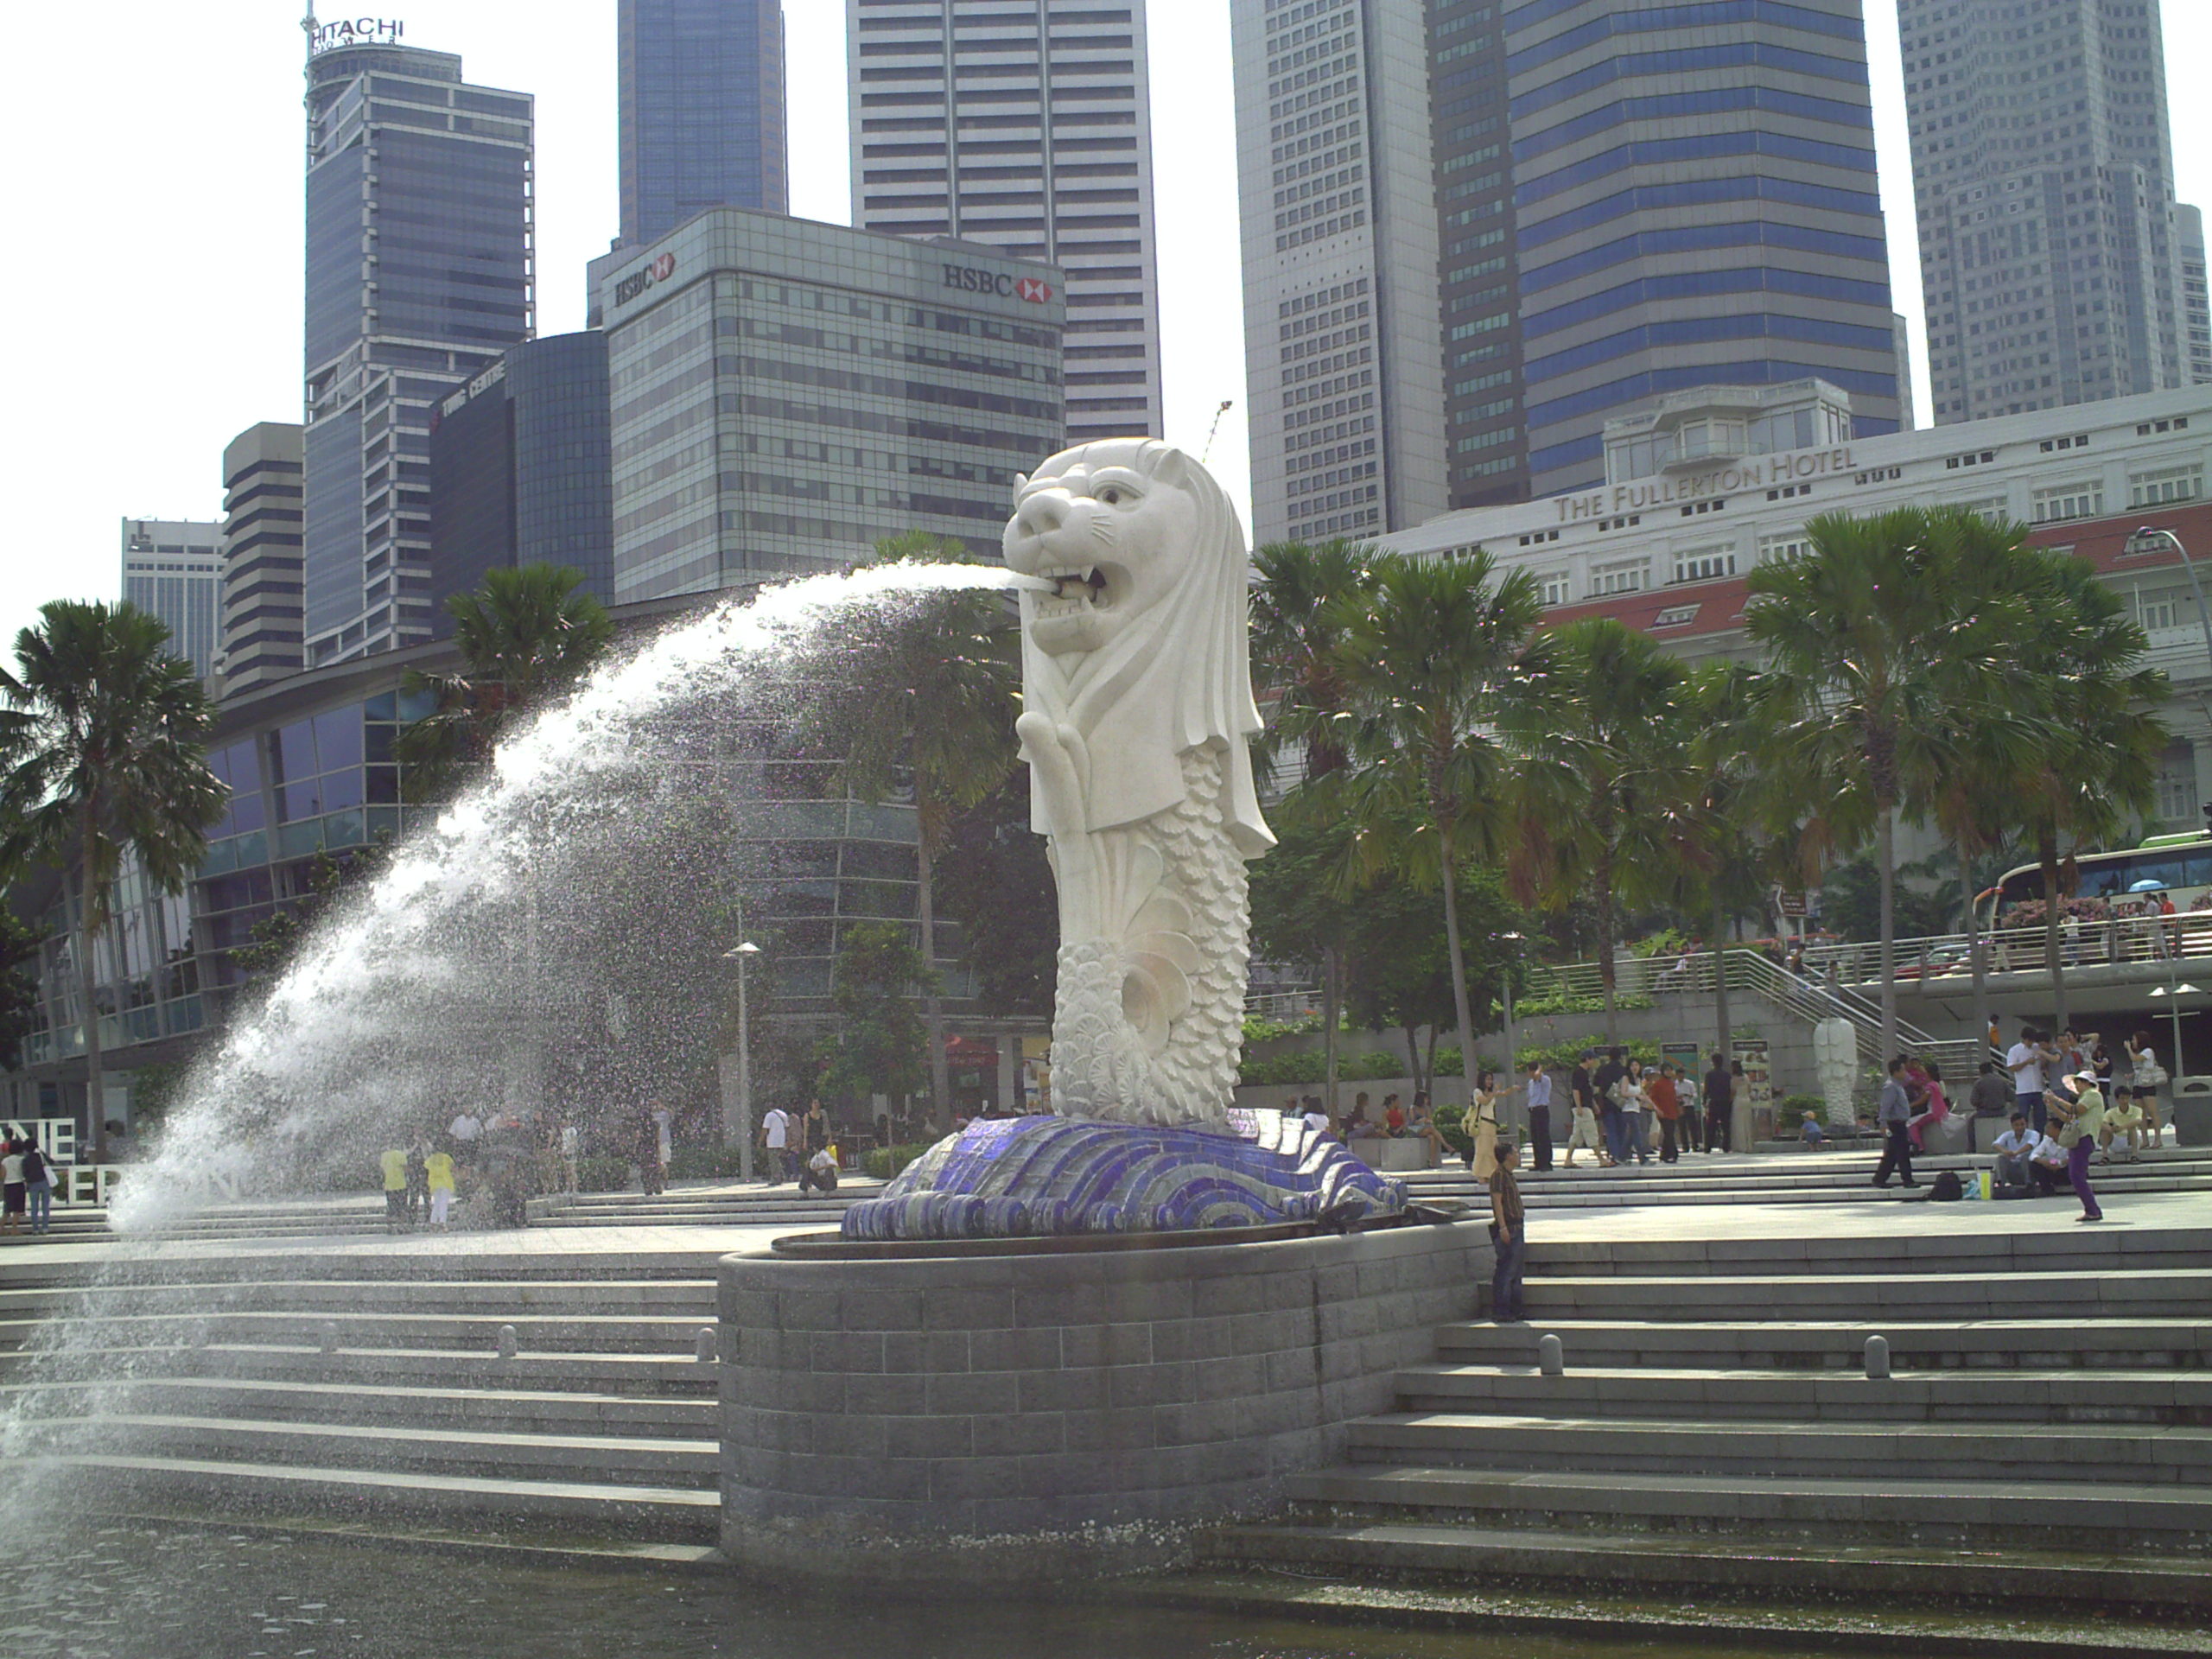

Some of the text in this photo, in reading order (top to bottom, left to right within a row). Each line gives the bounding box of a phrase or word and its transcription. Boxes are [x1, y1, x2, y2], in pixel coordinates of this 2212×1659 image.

[312, 17, 404, 48] HITACHI
[615, 264, 652, 308] HSBC
[943, 264, 1012, 297] HSBC
[1554, 447, 1857, 522] THE FULLERTON HOTEL
